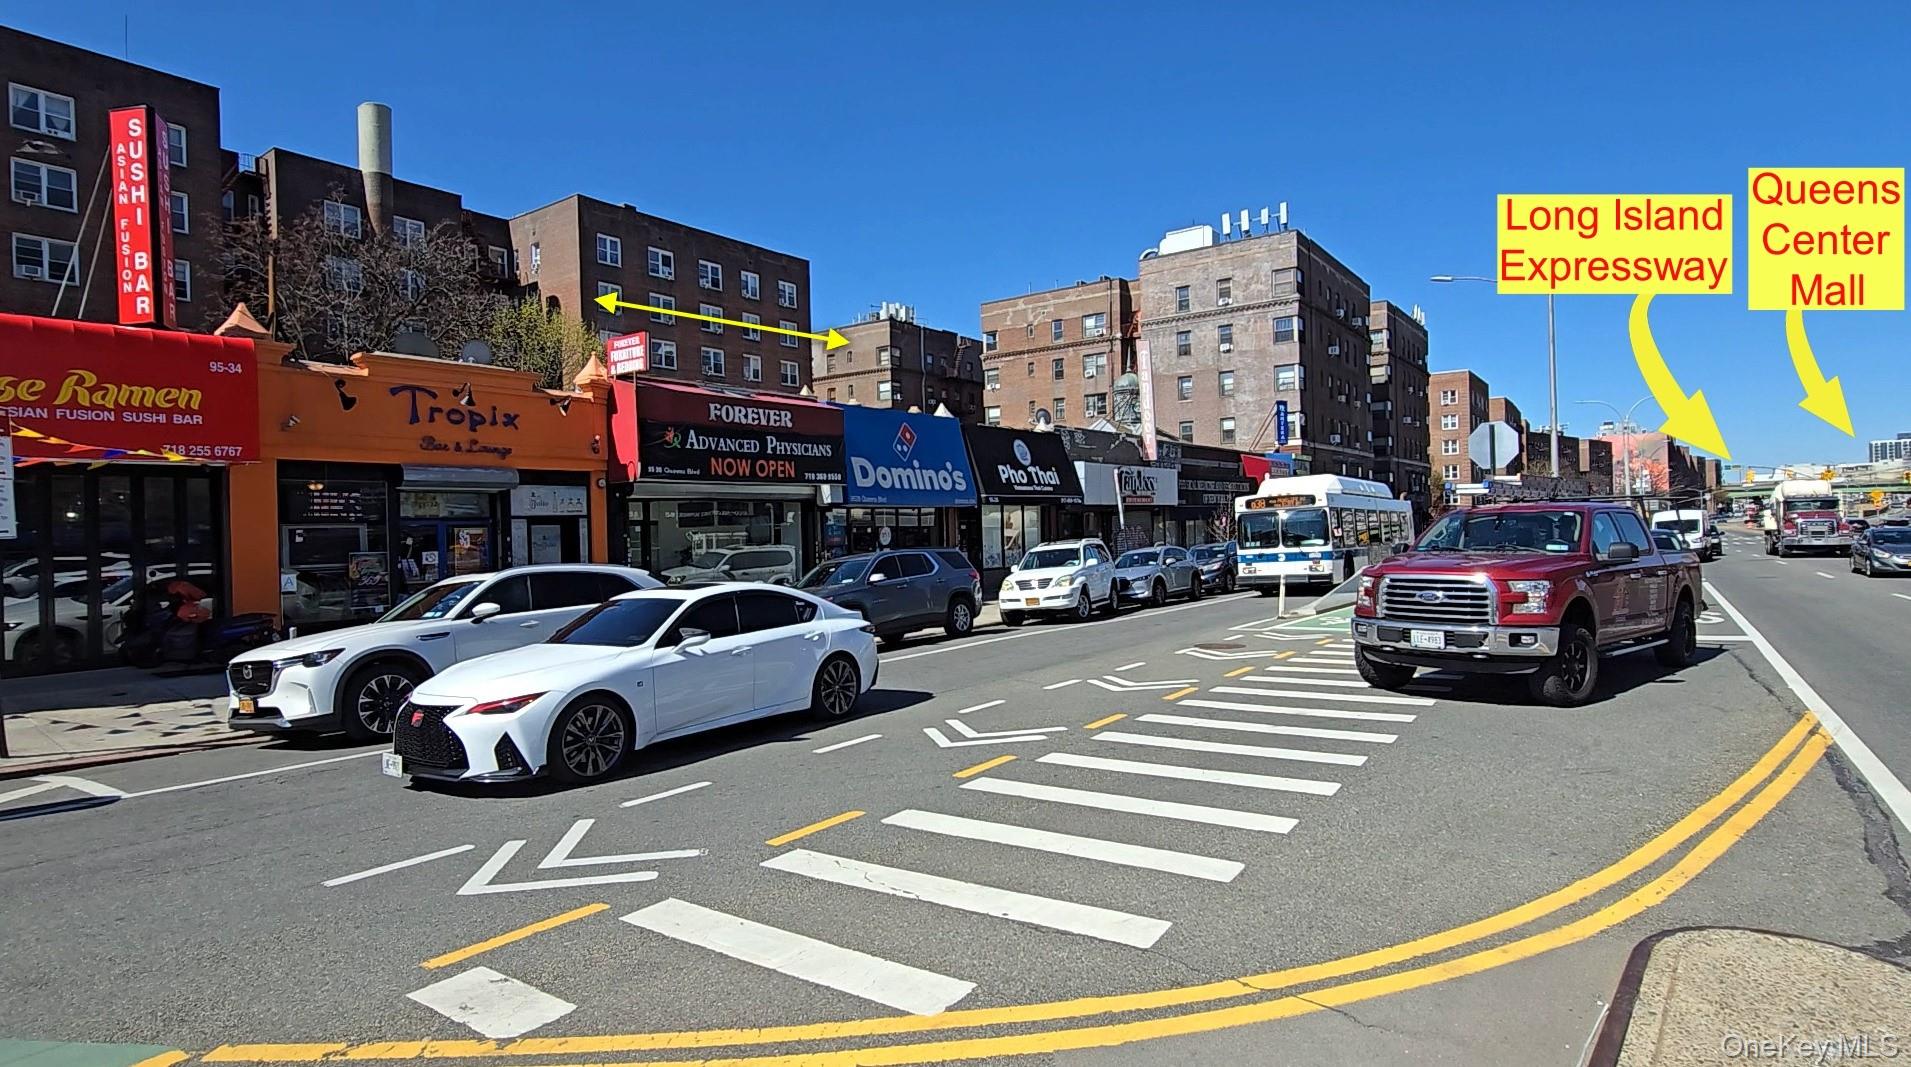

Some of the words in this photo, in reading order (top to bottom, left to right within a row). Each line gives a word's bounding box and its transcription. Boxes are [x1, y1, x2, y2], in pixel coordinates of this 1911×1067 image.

[115, 143, 128, 205] ASIAN
[128, 118, 145, 226] SUSHI
[120, 218, 132, 293] FUSION
[134, 251, 150, 315] BAR
[209, 361, 242, 374] 95-34
[52, 369, 202, 410] Ramen
[8, 406, 48, 419] SIAN
[55, 408, 115, 422] FUSION
[122, 411, 166, 424] SUSHI
[173, 414, 203, 425] BAR
[389, 384, 520, 432] Tropix
[708, 402, 793, 428] FOREVER
[163, 444, 186, 456] 718
[188, 445, 211, 456] 255
[214, 446, 243, 457] 6767
[710, 456, 751, 477] NOW
[755, 459, 796, 479] OPEN
[850, 456, 967, 491] Domino's
[997, 464, 1028, 485] Pho
[1028, 465, 1061, 486] Thai
